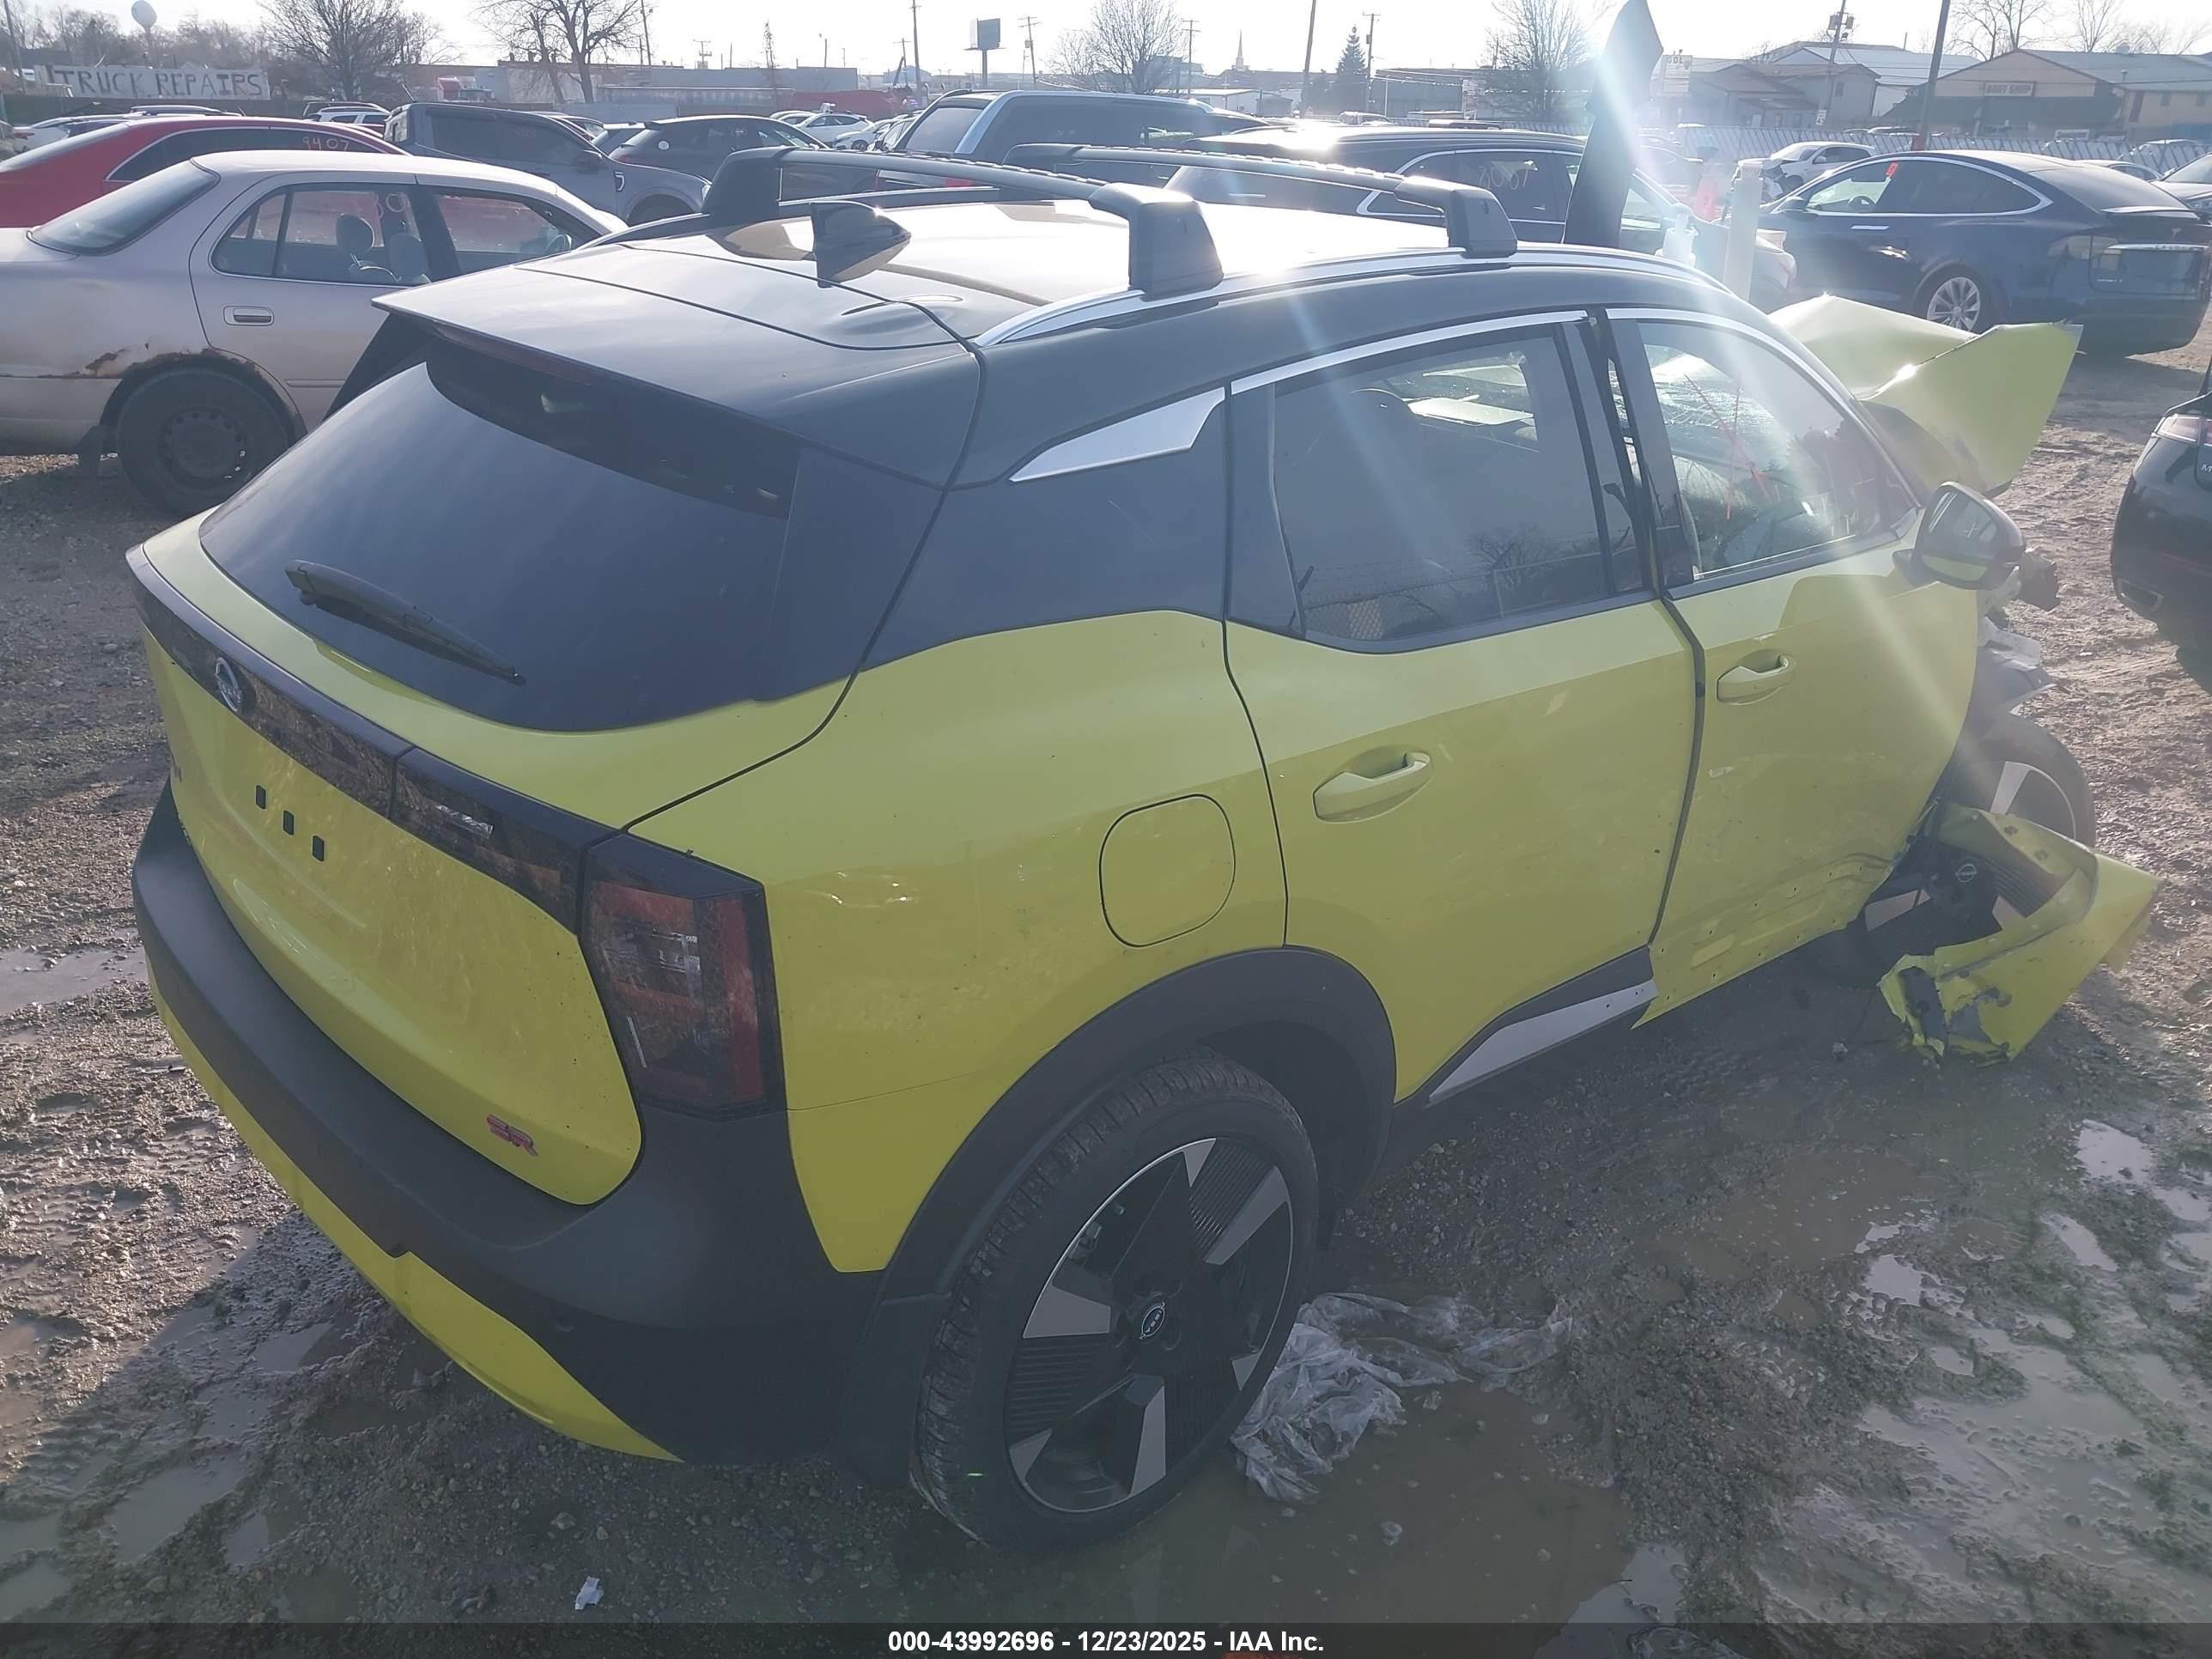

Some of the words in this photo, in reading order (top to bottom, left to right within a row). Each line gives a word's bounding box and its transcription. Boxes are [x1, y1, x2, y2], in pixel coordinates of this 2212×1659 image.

[54, 70, 144, 98] TRUCK
[155, 72, 259, 97] REPAIRS
[302, 137, 350, 151] 9407
[485, 1114, 538, 1157] SR
